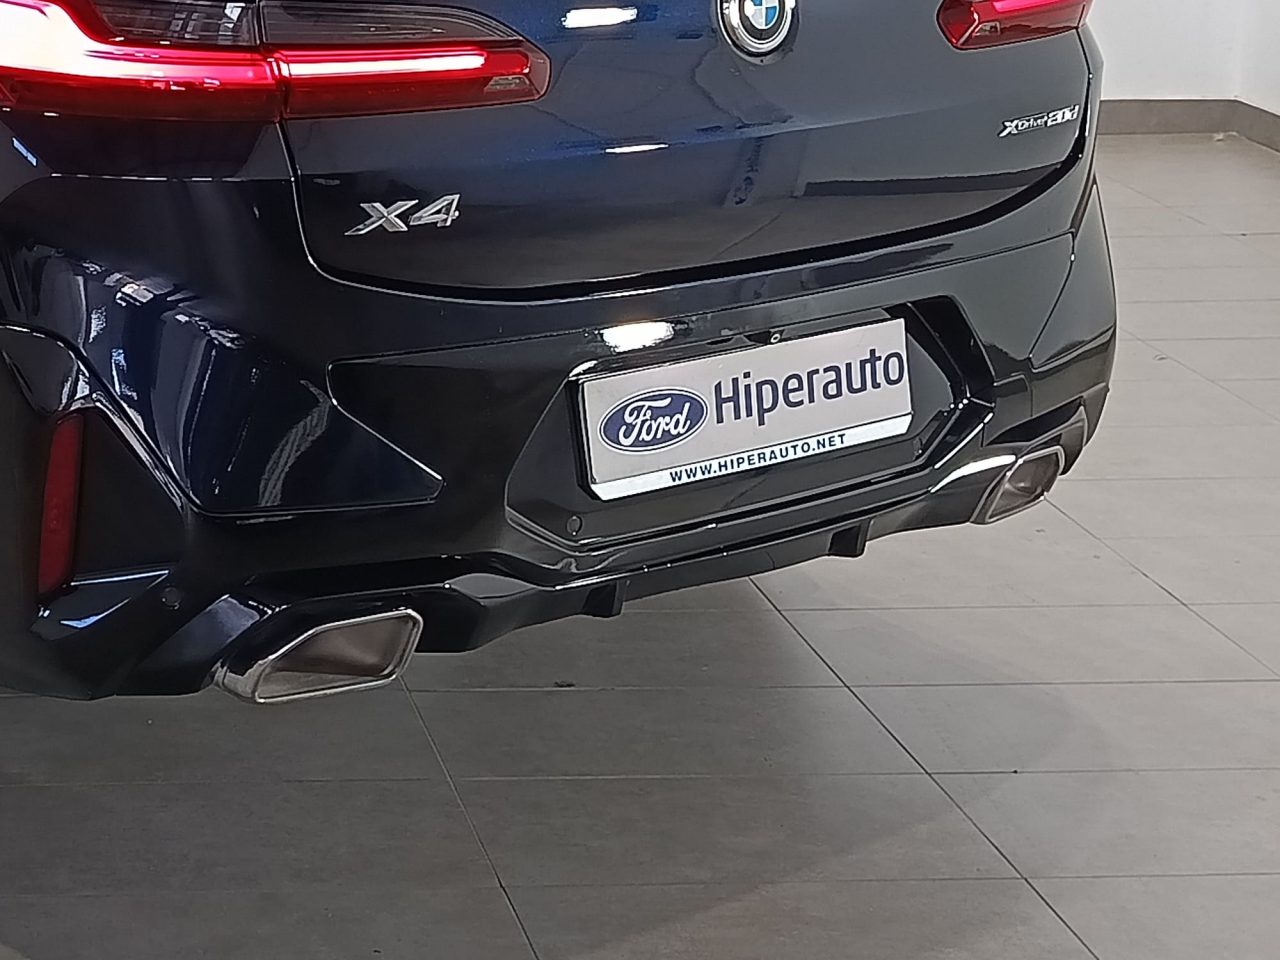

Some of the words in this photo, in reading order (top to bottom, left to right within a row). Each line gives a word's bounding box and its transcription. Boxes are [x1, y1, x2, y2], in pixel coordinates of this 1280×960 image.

[344, 193, 461, 236] X4
[713, 347, 906, 427] Hiperauto
[618, 396, 692, 447] Ford
[669, 432, 847, 484] WWW.HIPERAUTO.NET
